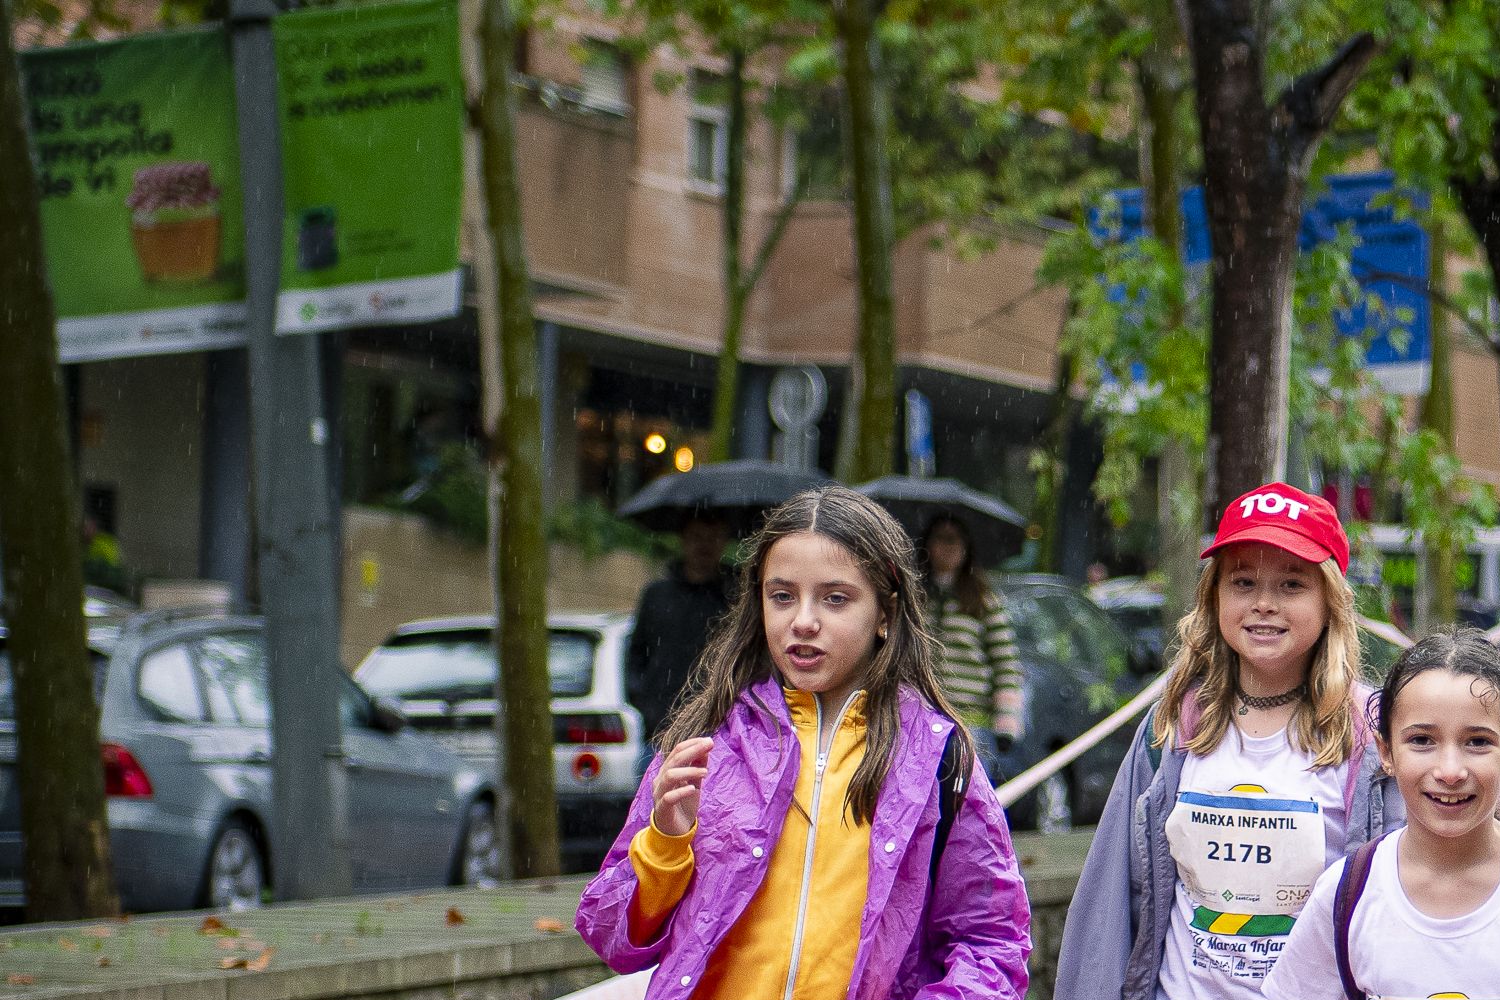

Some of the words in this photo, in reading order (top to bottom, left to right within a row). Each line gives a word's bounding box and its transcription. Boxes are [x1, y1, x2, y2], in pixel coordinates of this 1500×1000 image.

[1240, 493, 1309, 521] TOT
[1192, 811, 1234, 827] MARXA
[1238, 816, 1298, 830] INFANTIL
[1207, 841, 1272, 864] 217B
[1276, 889, 1311, 901] ONA
[1207, 936, 1247, 953] Marxa
